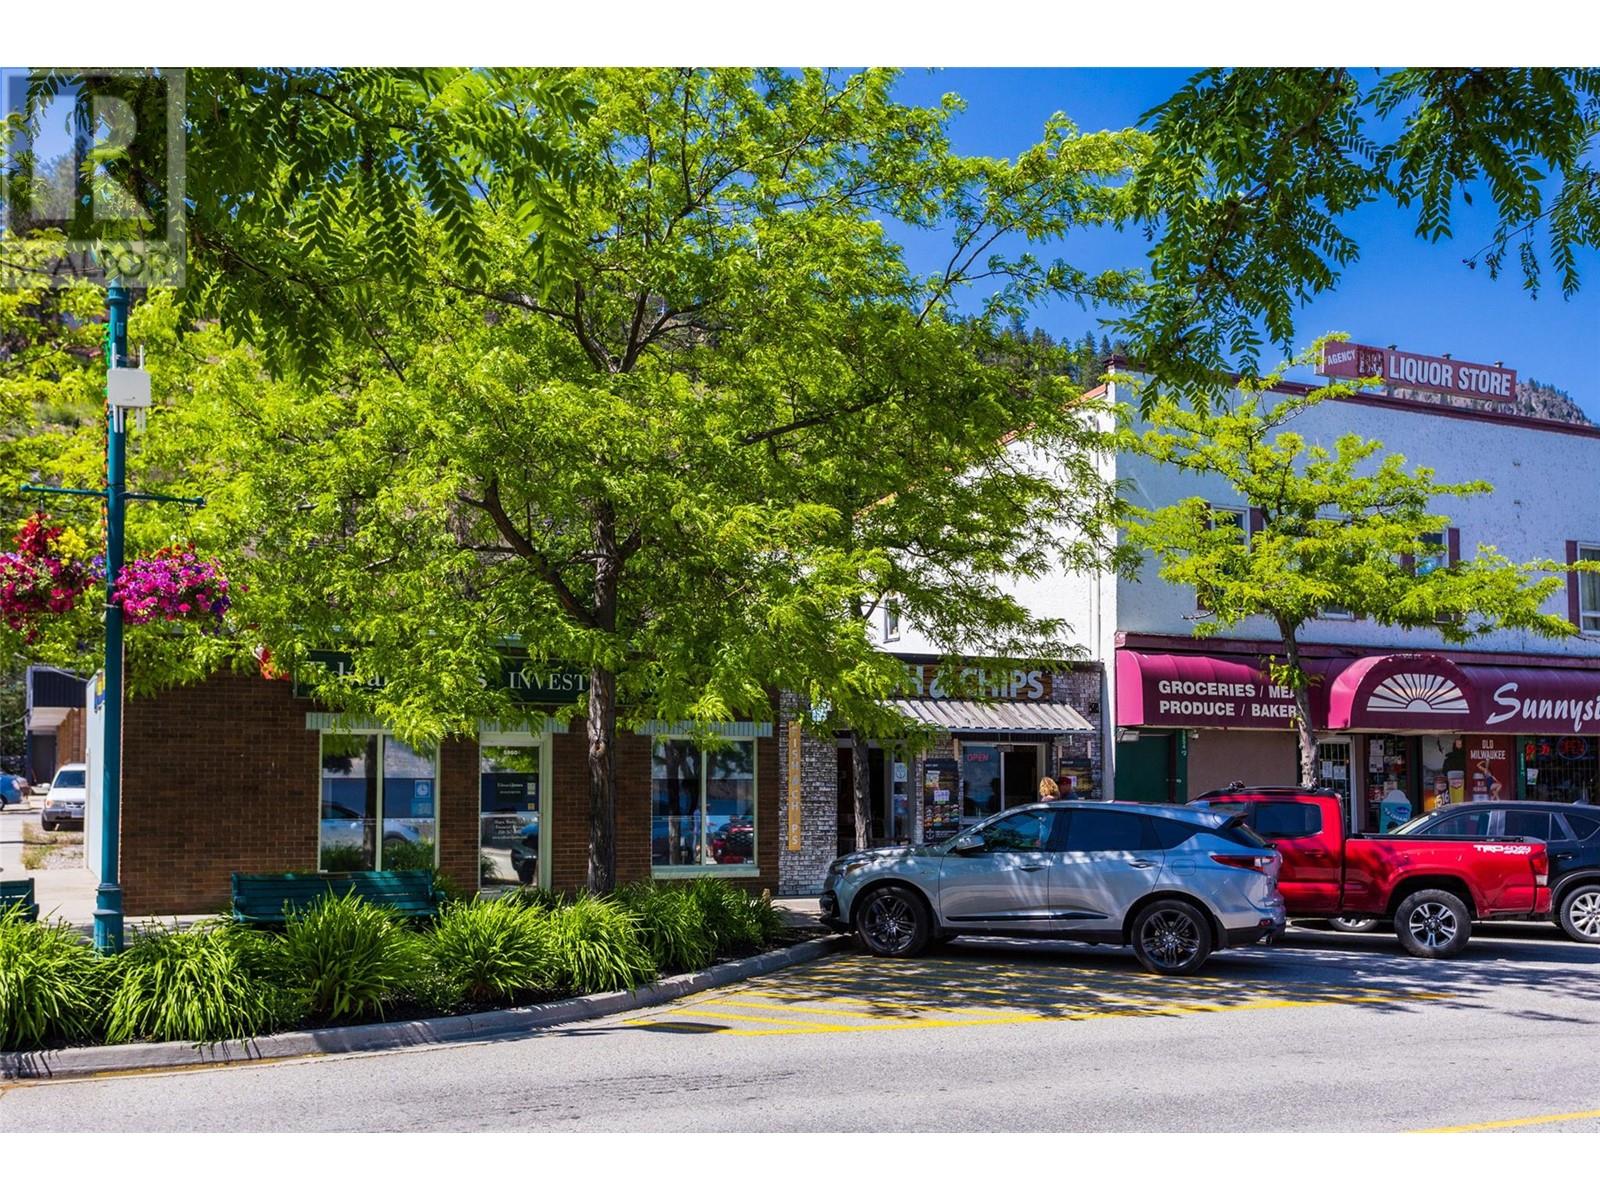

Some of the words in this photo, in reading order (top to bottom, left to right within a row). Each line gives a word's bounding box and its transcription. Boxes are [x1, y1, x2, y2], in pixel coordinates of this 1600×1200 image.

[1327, 350, 1356, 366] AGENCY
[1389, 355, 1453, 388] LIQUOR
[1458, 367, 1511, 396] STORE
[508, 671, 588, 691] INVEST
[960, 668, 1044, 699] CHIPS
[1158, 680, 1256, 697] GROCERIES
[1259, 685, 1264, 698] /
[1159, 700, 1236, 716] PRODUCE
[1241, 704, 1246, 717] /
[1251, 704, 1297, 718] BAKER
[1481, 739, 1494, 750] OLD
[967, 753, 989, 761] OPEN
[1470, 750, 1506, 761] MILWAUKEE
